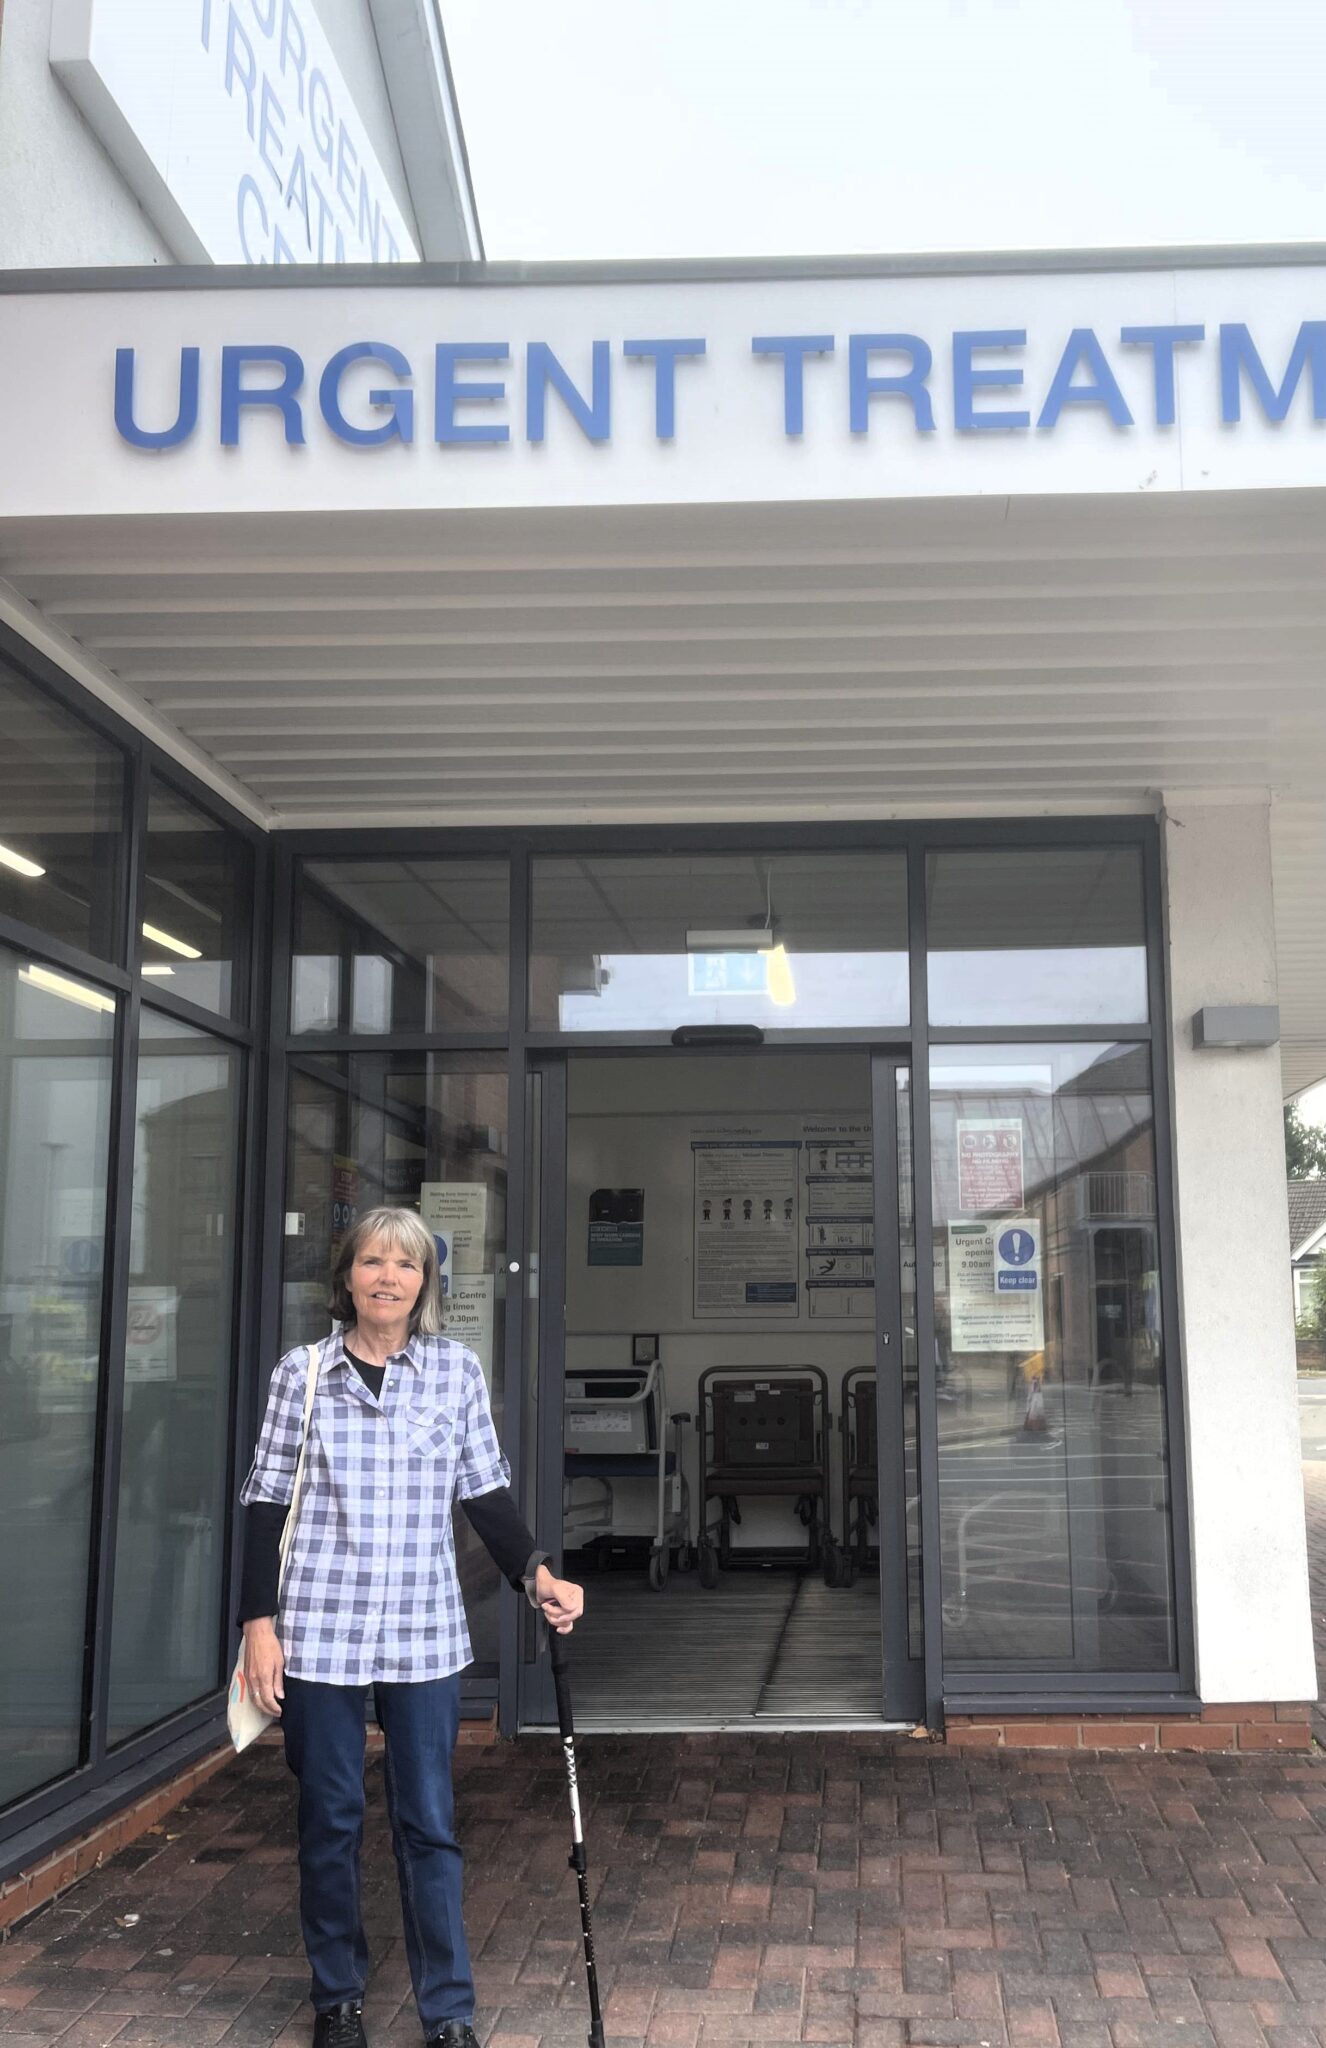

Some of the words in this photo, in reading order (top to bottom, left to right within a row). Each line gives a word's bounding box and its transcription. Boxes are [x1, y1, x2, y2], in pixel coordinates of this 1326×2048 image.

[114, 338, 706, 449] URGENT
[751, 320, 1326, 435] TREATM
[955, 1237, 983, 1247] Urgent
[961, 1260, 991, 1269] 9.00am
[1000, 1276, 1017, 1285] Keep
[1018, 1276, 1036, 1284] clear
[459, 1291, 487, 1300] Centre
[453, 1302, 475, 1311] times
[449, 1314, 479, 1324] 9.30pm
